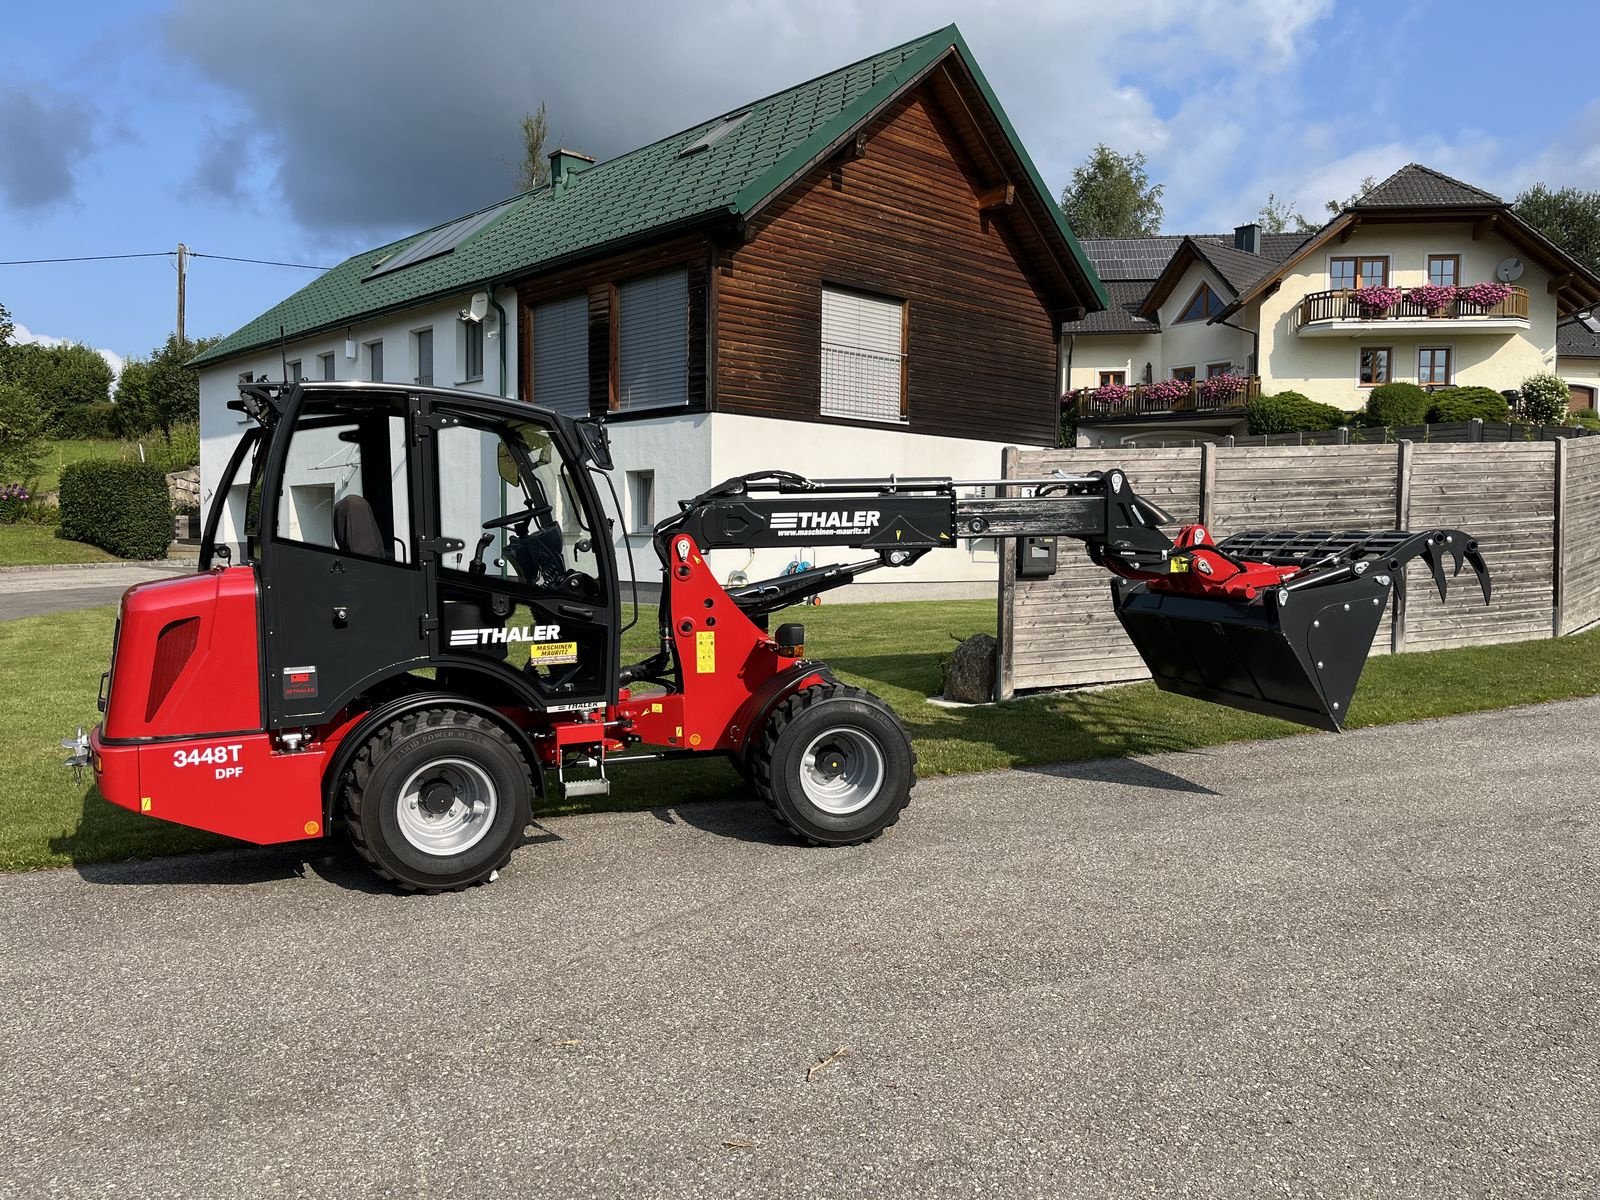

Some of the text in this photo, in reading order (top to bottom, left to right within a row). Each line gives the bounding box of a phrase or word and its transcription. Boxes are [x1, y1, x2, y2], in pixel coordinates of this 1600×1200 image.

[798, 510, 881, 528] THALER
[777, 527, 871, 537] www.maschinen-mauritz.at
[478, 624, 561, 644] THALER
[536, 643, 573, 651] MASCHINEN
[422, 731, 454, 742] POWER
[173, 744, 243, 768] 3448T
[215, 766, 244, 780] DPF
